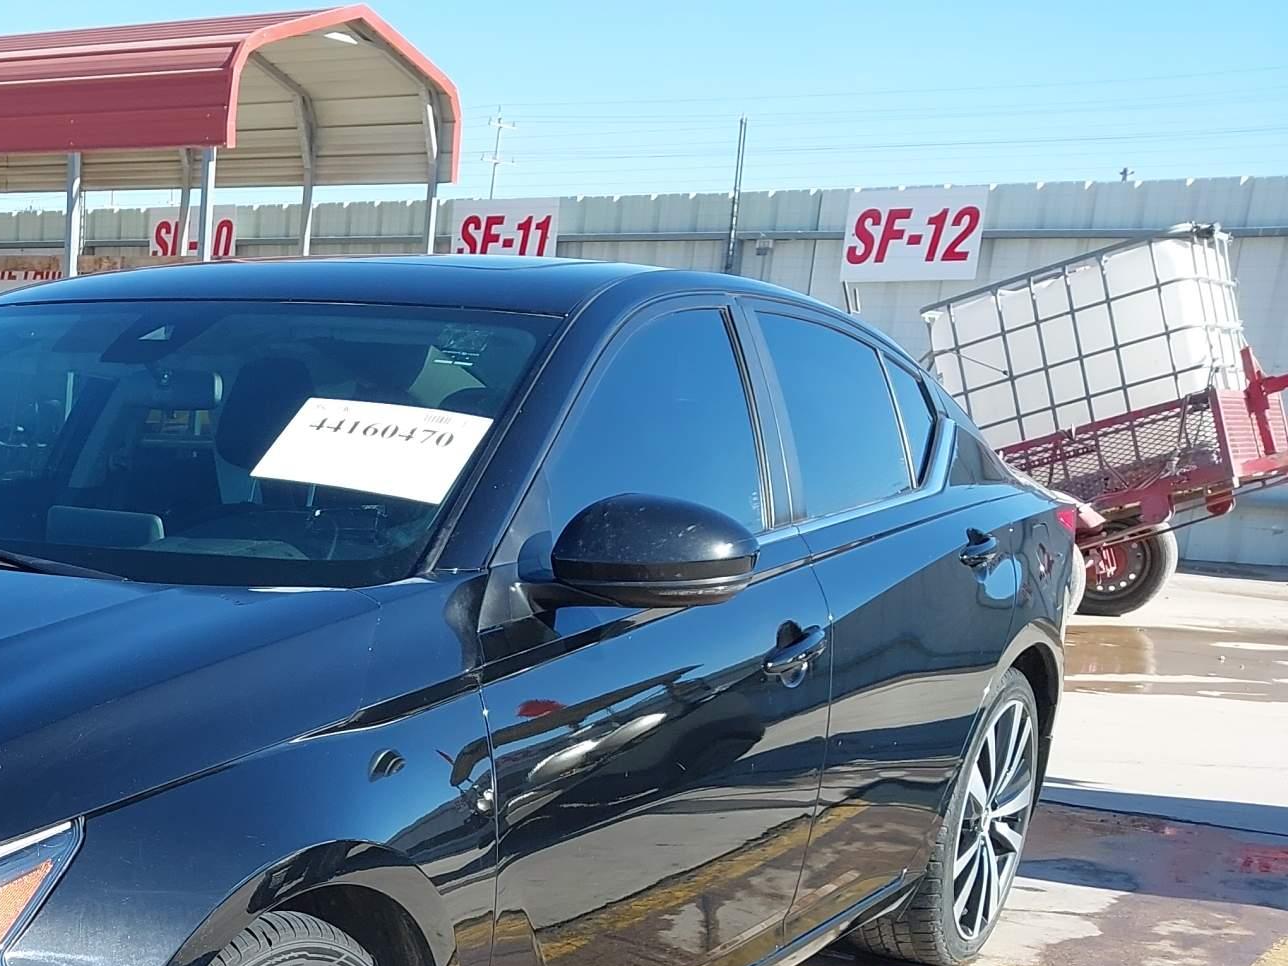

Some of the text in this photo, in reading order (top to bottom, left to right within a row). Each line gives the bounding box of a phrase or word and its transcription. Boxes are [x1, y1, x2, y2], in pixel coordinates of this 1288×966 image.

[457, 214, 552, 256] SF-11
[846, 206, 981, 264] SF-12
[309, 418, 454, 446] 44160470
